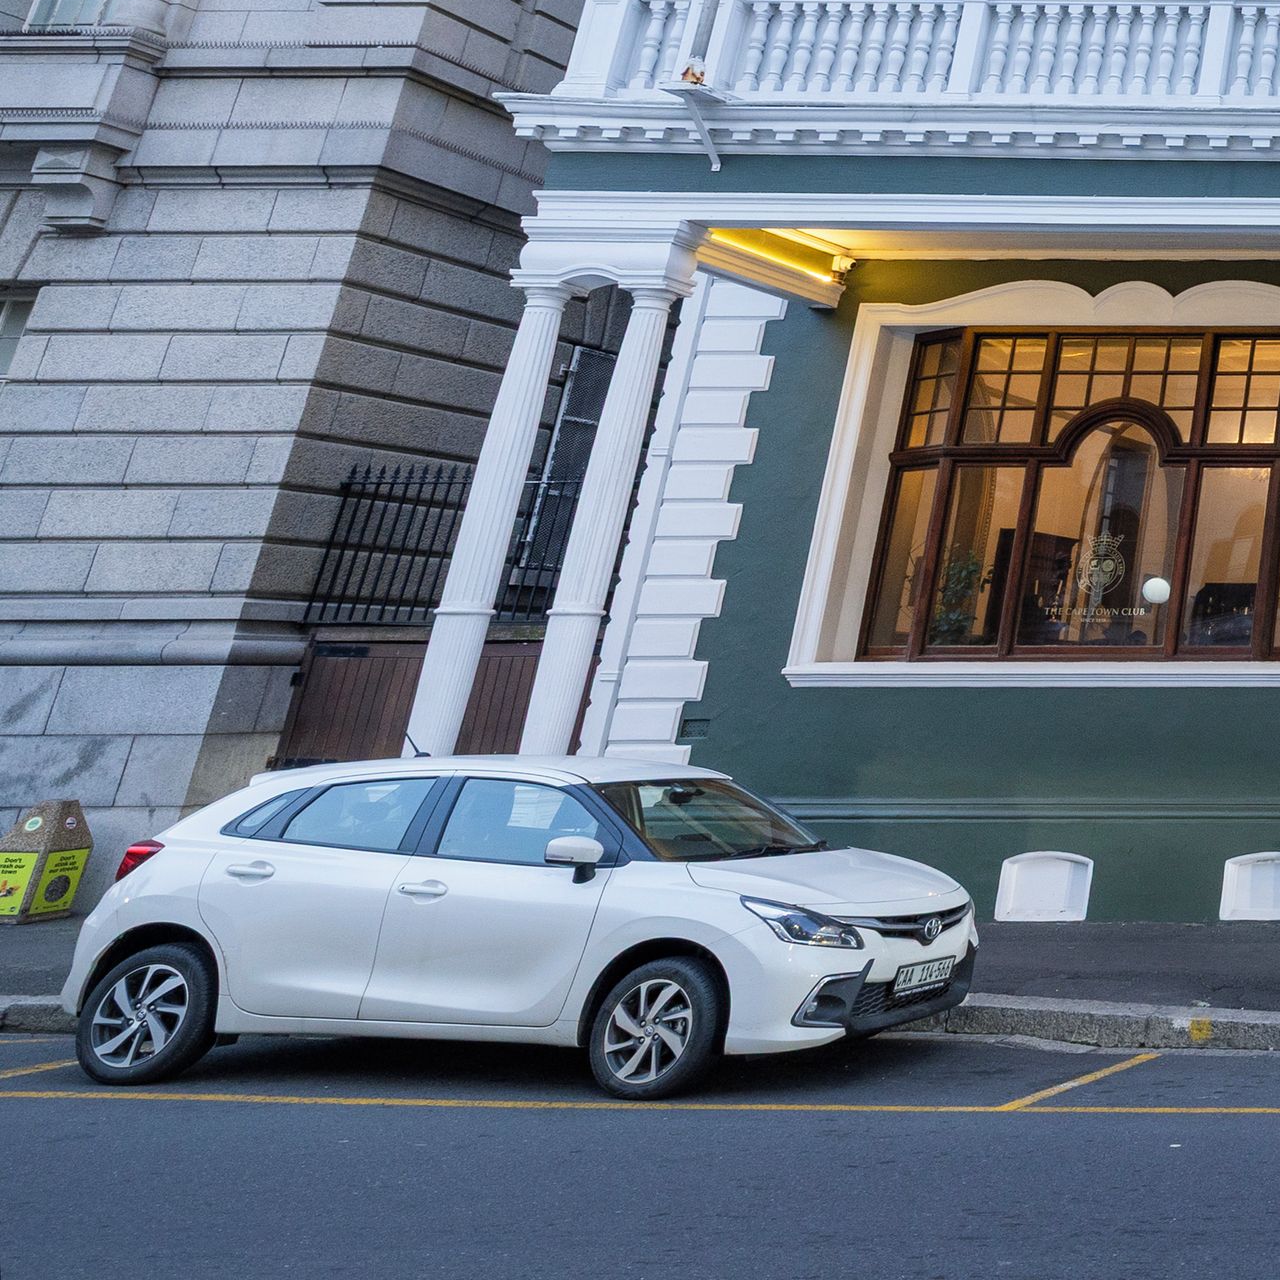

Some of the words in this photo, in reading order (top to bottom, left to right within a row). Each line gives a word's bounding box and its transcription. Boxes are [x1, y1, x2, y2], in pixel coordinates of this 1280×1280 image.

[1045, 607, 1063, 616] THE
[1065, 607, 1088, 616] CAPE
[1091, 607, 1119, 616] TOWN
[1121, 607, 1145, 616] CLUB
[896, 968, 915, 987] CAA
